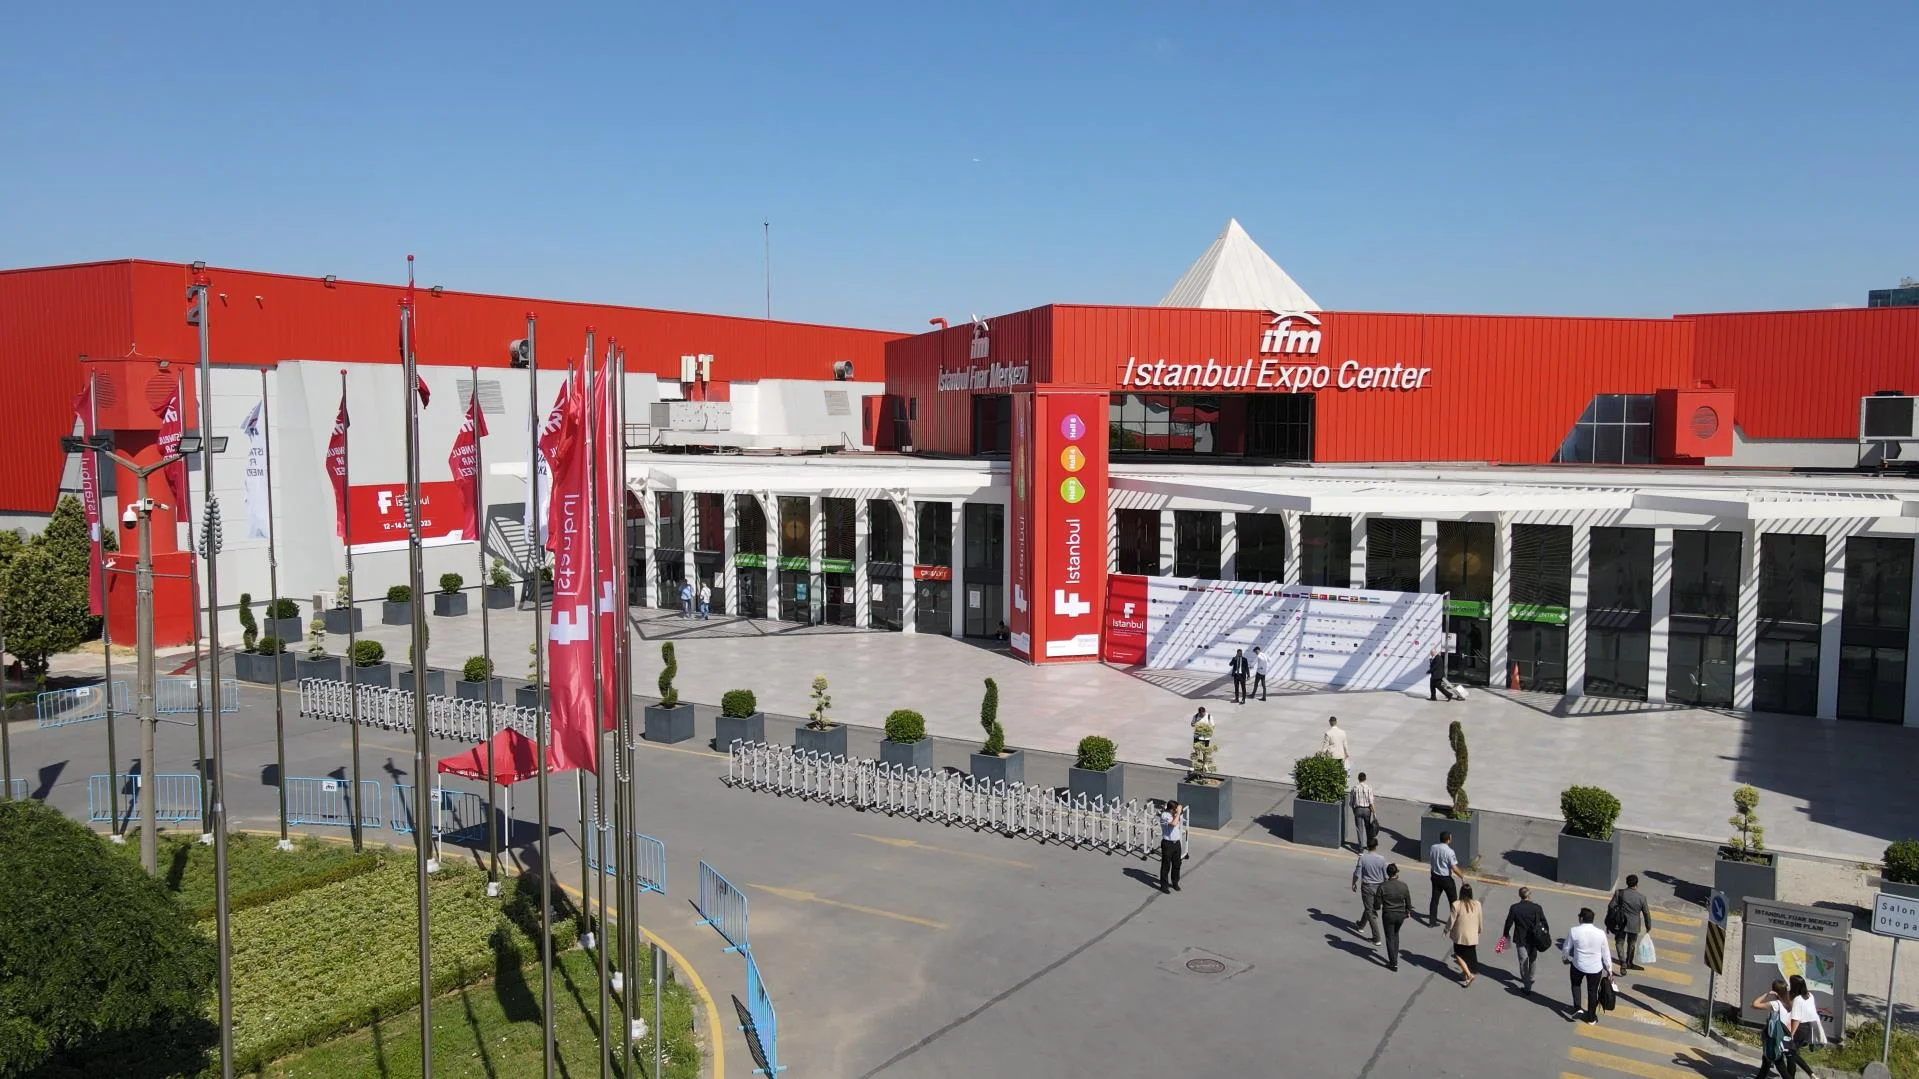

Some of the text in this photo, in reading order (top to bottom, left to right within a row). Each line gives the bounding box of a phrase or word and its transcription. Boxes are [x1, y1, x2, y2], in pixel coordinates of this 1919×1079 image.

[1260, 320, 1322, 354] ifm
[1122, 357, 1431, 393] Istanbul Expo Center
[1066, 519, 1080, 583] Istanbul
[1112, 619, 1144, 629] Istanbul
[1881, 902, 1916, 915] Salon
[1880, 917, 1919, 930] Otopa
